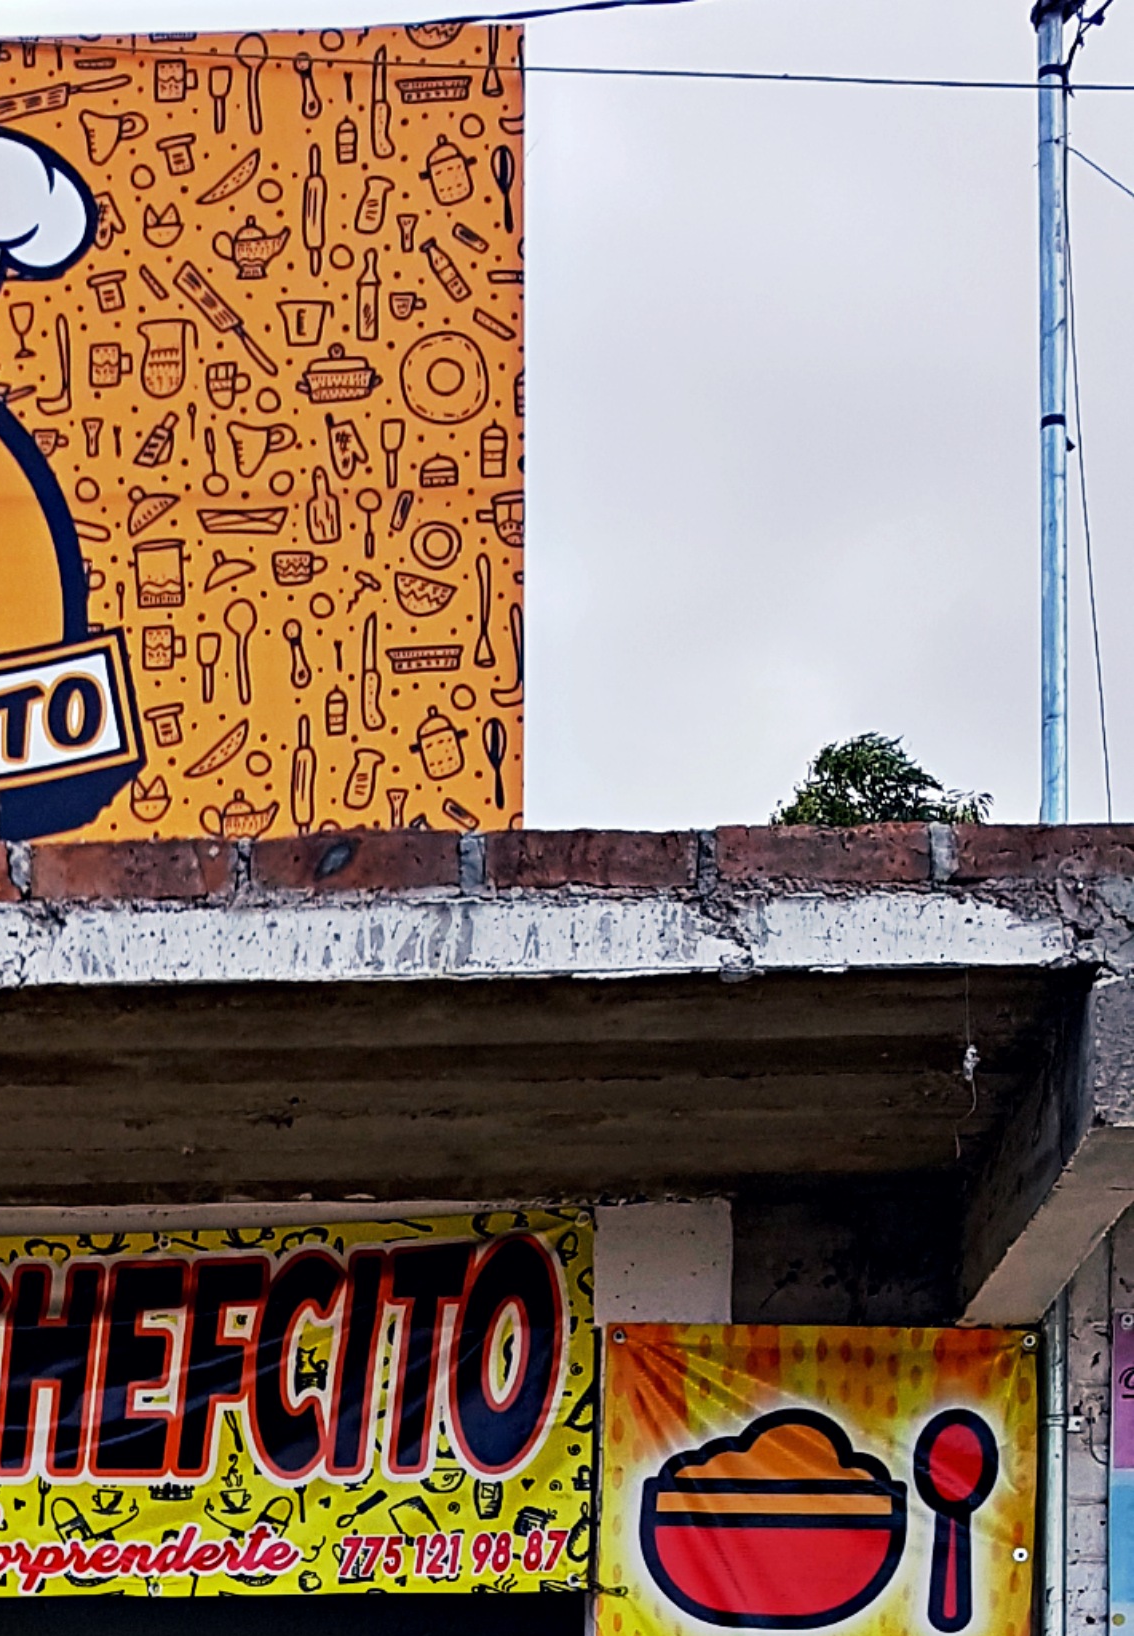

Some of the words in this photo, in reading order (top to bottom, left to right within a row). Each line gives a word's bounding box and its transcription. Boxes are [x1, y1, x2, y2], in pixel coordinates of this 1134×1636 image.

[338, 1535, 404, 1576] 775
[414, 1532, 461, 1575] 121
[471, 1531, 512, 1574] 98
[522, 1529, 569, 1572] 87
